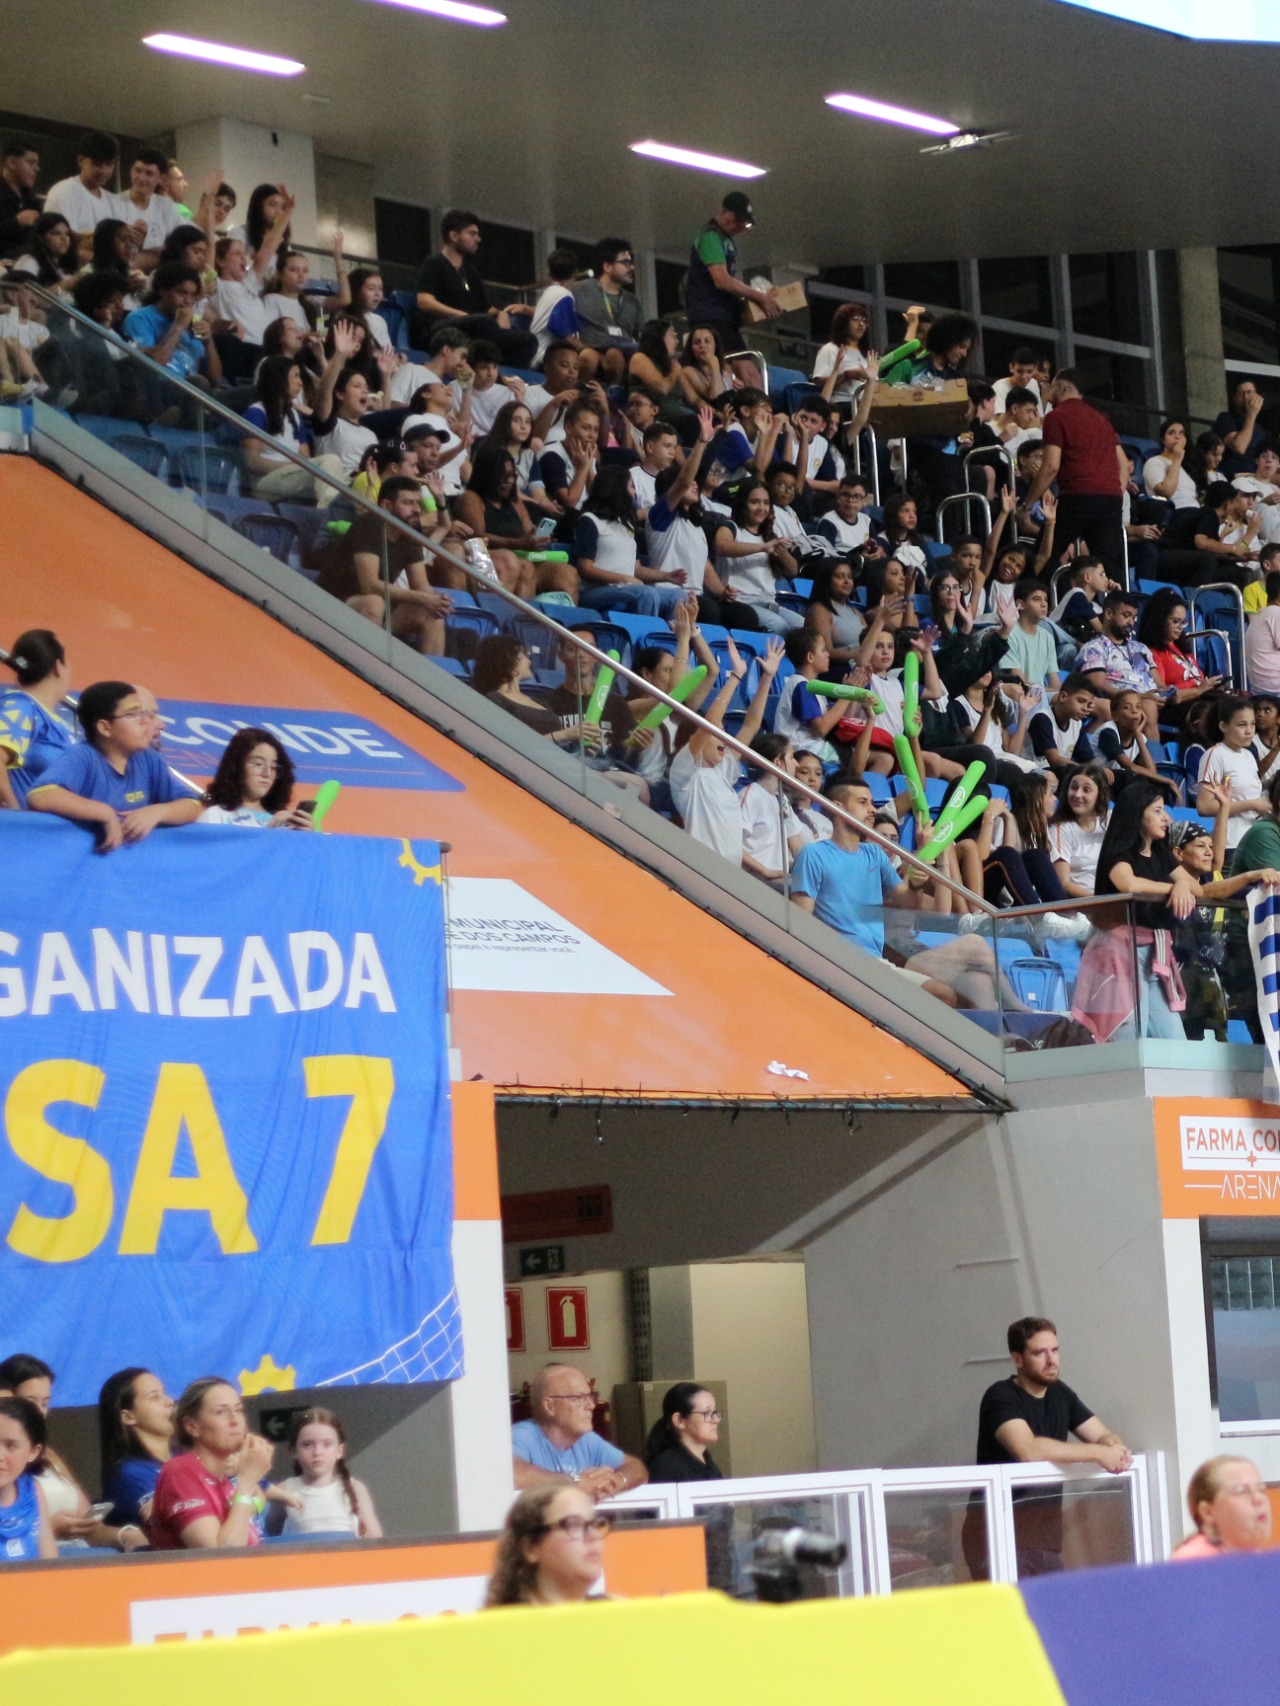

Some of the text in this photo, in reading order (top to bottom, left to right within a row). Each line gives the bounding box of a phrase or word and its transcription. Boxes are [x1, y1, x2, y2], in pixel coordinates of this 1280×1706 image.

[448, 917, 564, 932] MUNICIPAL
[459, 931, 503, 942] DOS
[502, 933, 581, 945] CAMPOS
[1186, 1127, 1247, 1151] FARMA
[302, 1054, 395, 1246] 7
